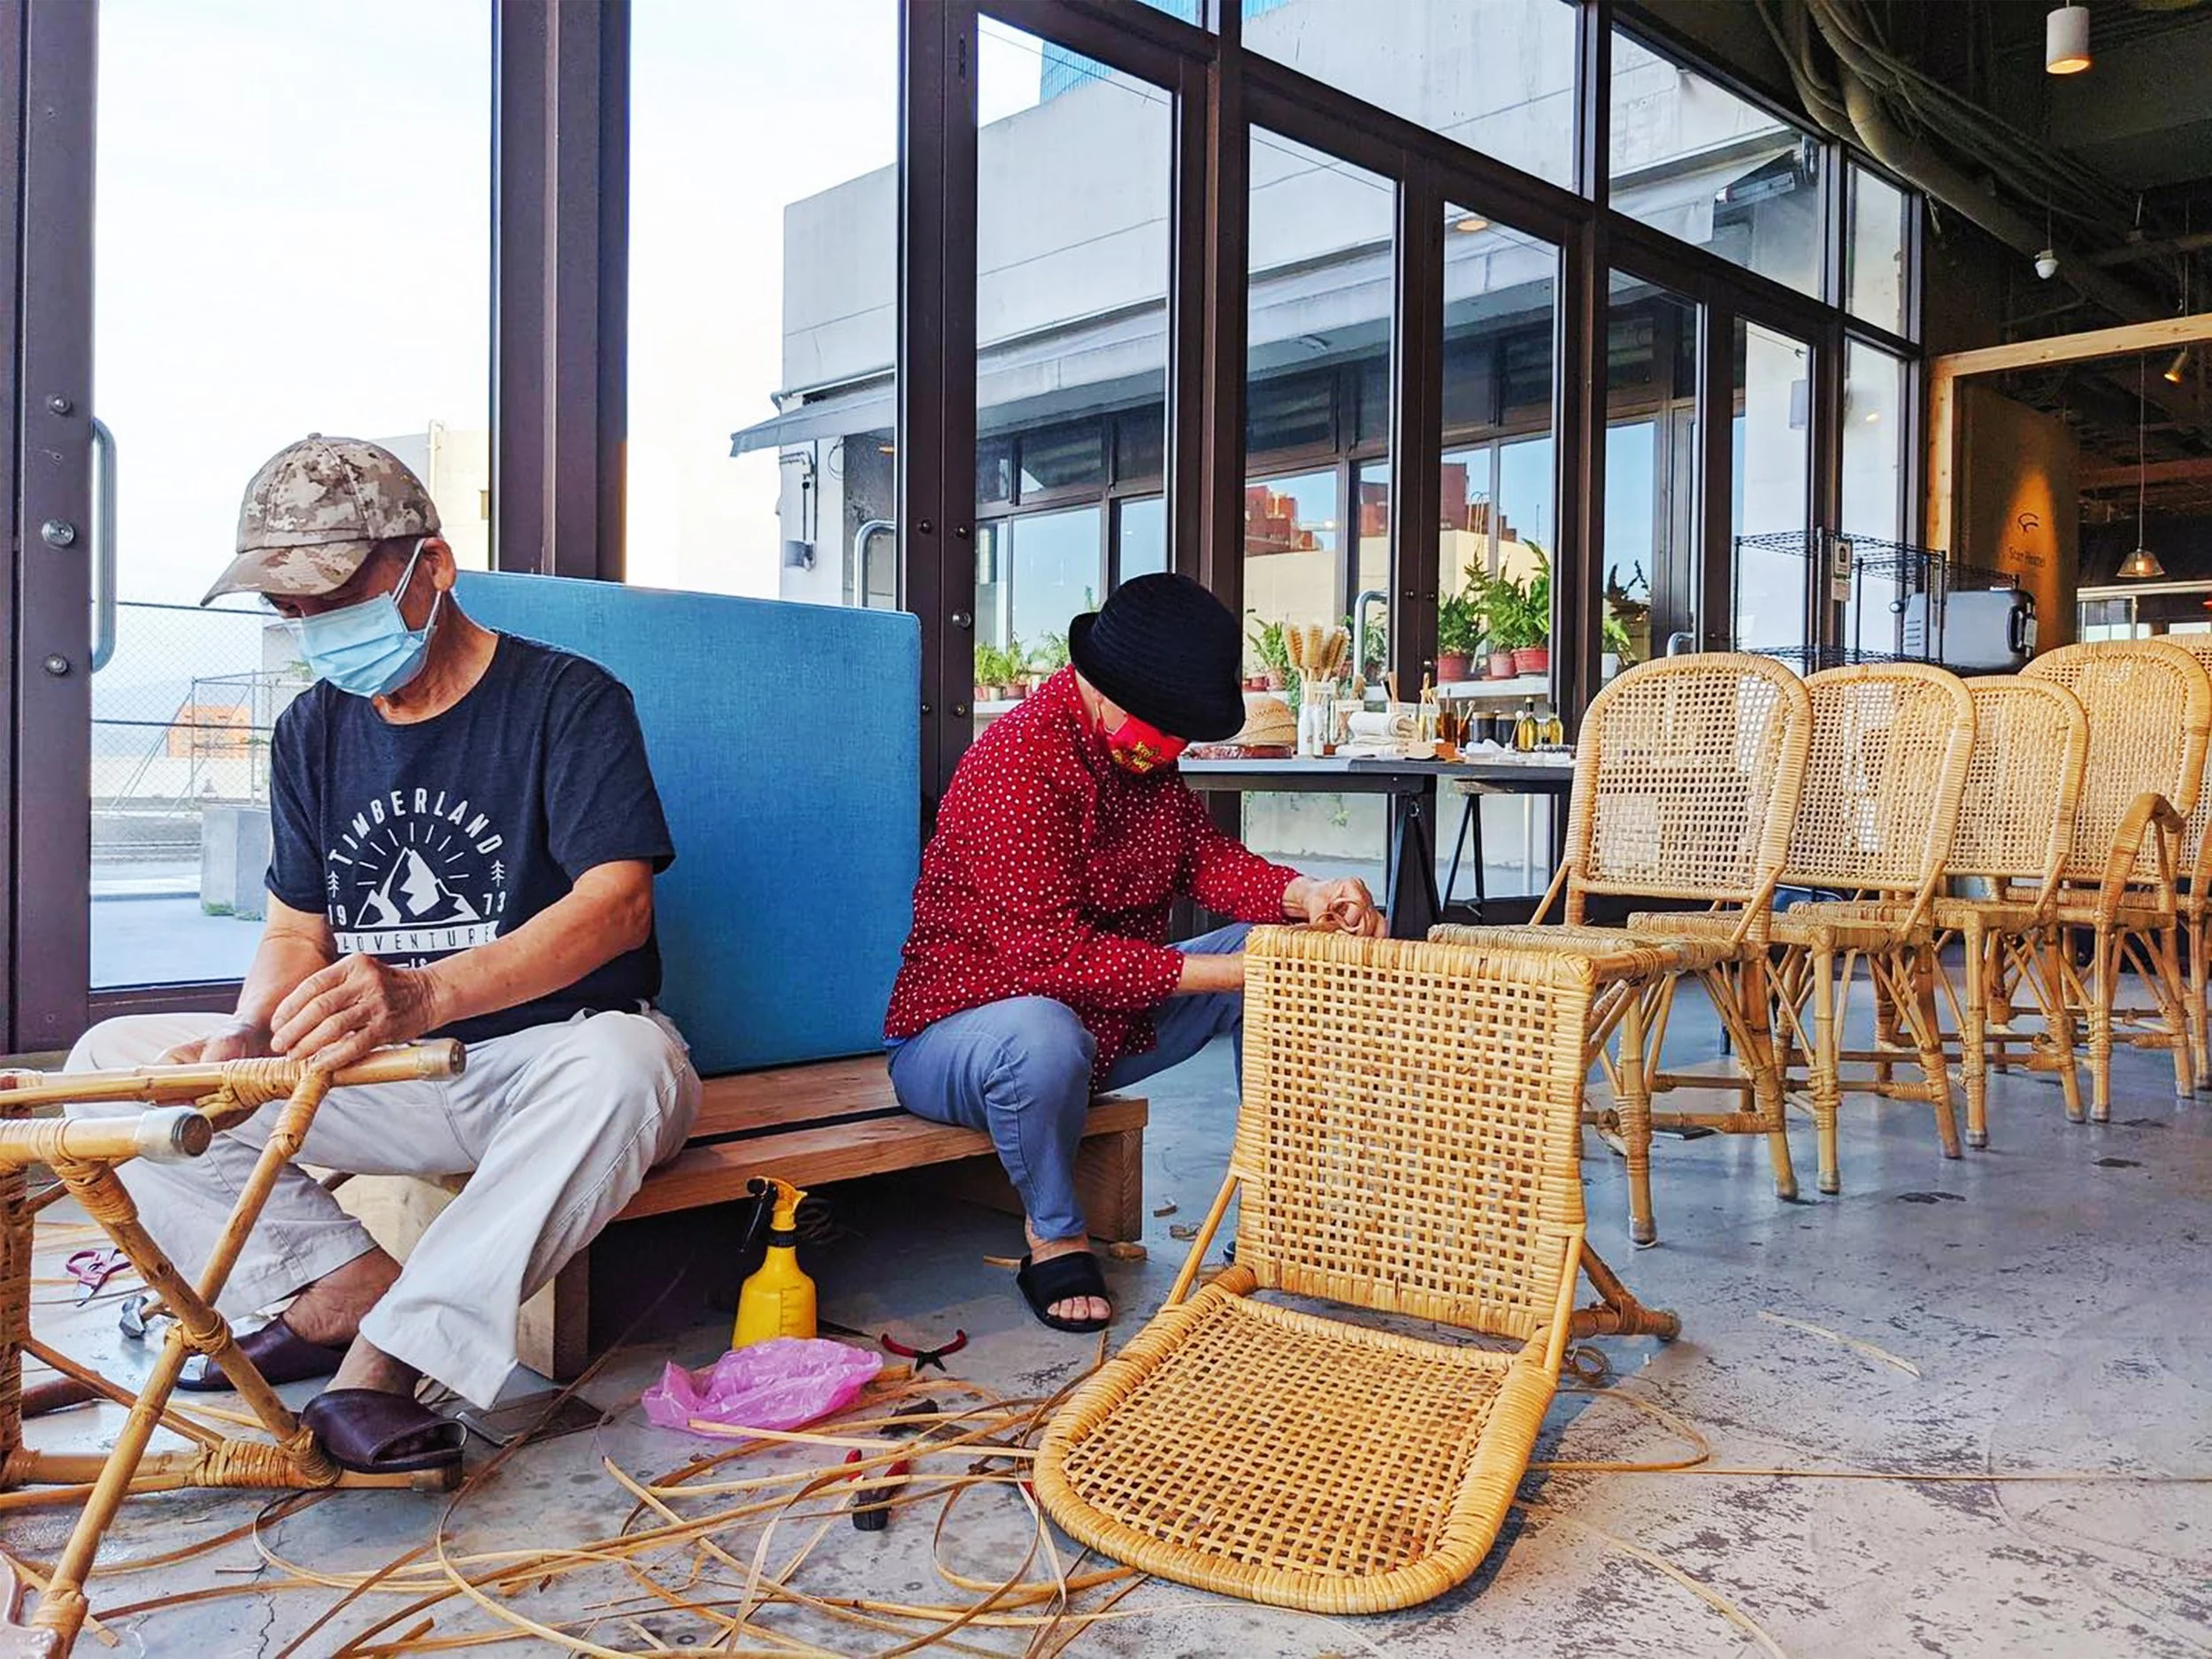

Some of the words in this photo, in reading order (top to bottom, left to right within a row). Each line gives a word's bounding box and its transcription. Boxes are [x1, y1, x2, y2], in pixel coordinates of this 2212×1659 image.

[328, 787, 503, 865] TIMBERLAND
[327, 904, 348, 926] 19
[482, 892, 506, 916] 73
[342, 928, 490, 952] ADVENTURE
